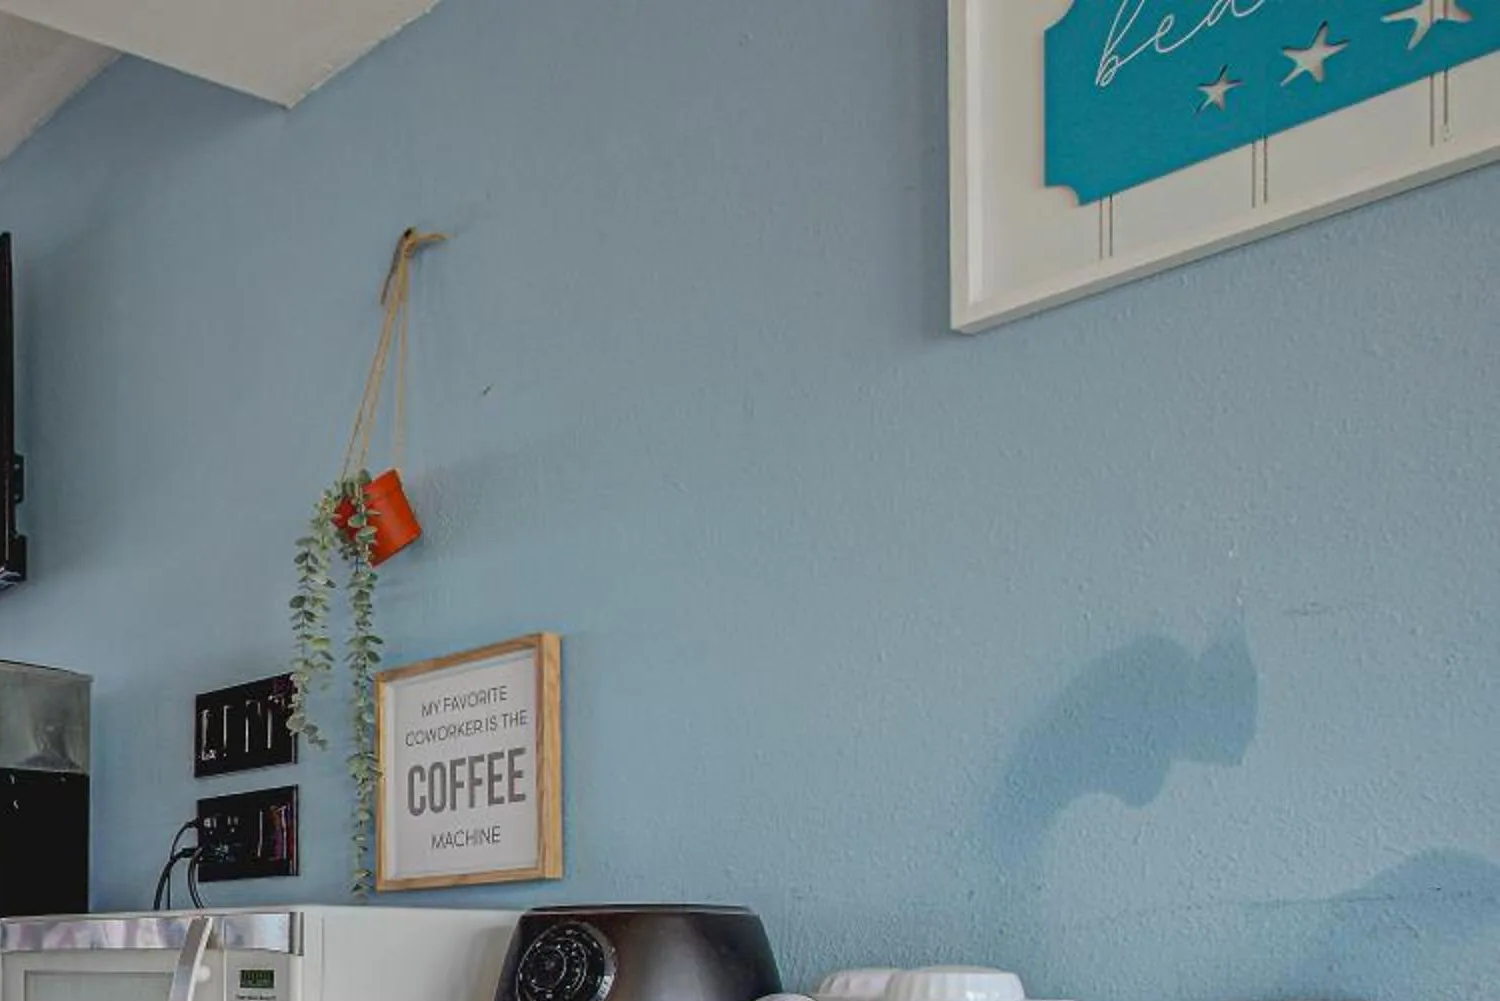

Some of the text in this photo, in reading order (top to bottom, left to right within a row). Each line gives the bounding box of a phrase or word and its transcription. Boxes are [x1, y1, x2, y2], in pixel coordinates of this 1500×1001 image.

[421, 685, 508, 718] MY FAVORITE
[405, 709, 528, 747] COWORKER IS THE
[407, 747, 527, 817] COFFEE
[431, 825, 501, 850] MACHINE
